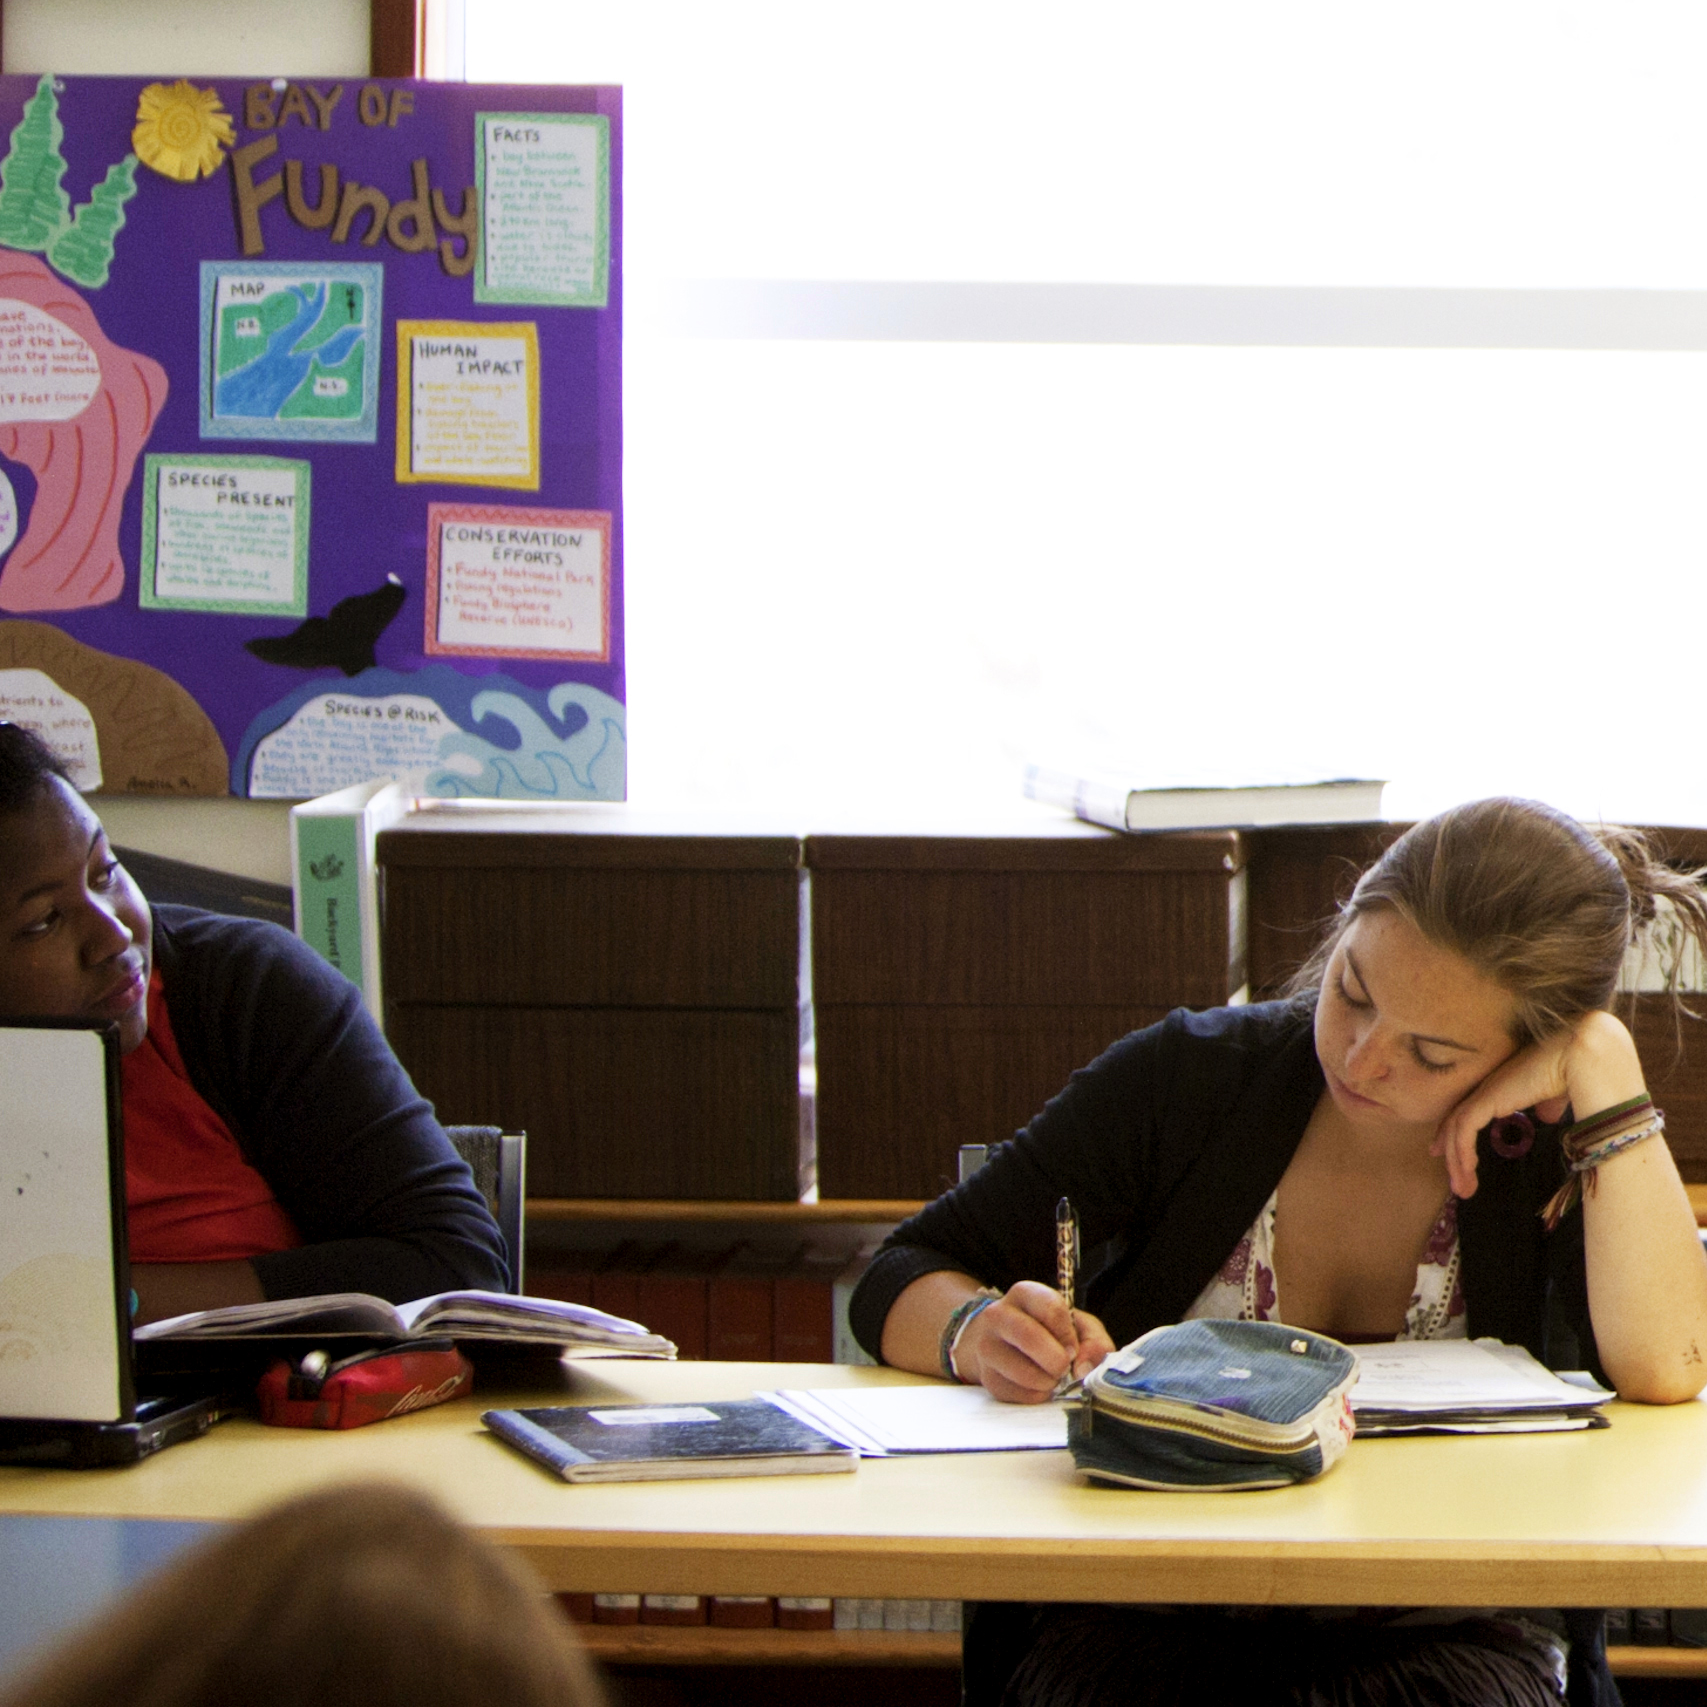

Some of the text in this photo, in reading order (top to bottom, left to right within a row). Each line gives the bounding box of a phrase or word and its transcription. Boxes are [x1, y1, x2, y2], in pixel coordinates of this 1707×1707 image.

[243, 83, 414, 131] BAY OF
[494, 126, 542, 144] FACTS
[228, 134, 480, 277] Fundy
[230, 282, 266, 298] MAP
[419, 341, 478, 360] HUMAN
[456, 360, 524, 376] IMPACT
[167, 472, 238, 490] SPECIES
[217, 490, 296, 509] PRESENT
[444, 526, 584, 548] CONSERVATION
[492, 548, 564, 567] EFFORTS
